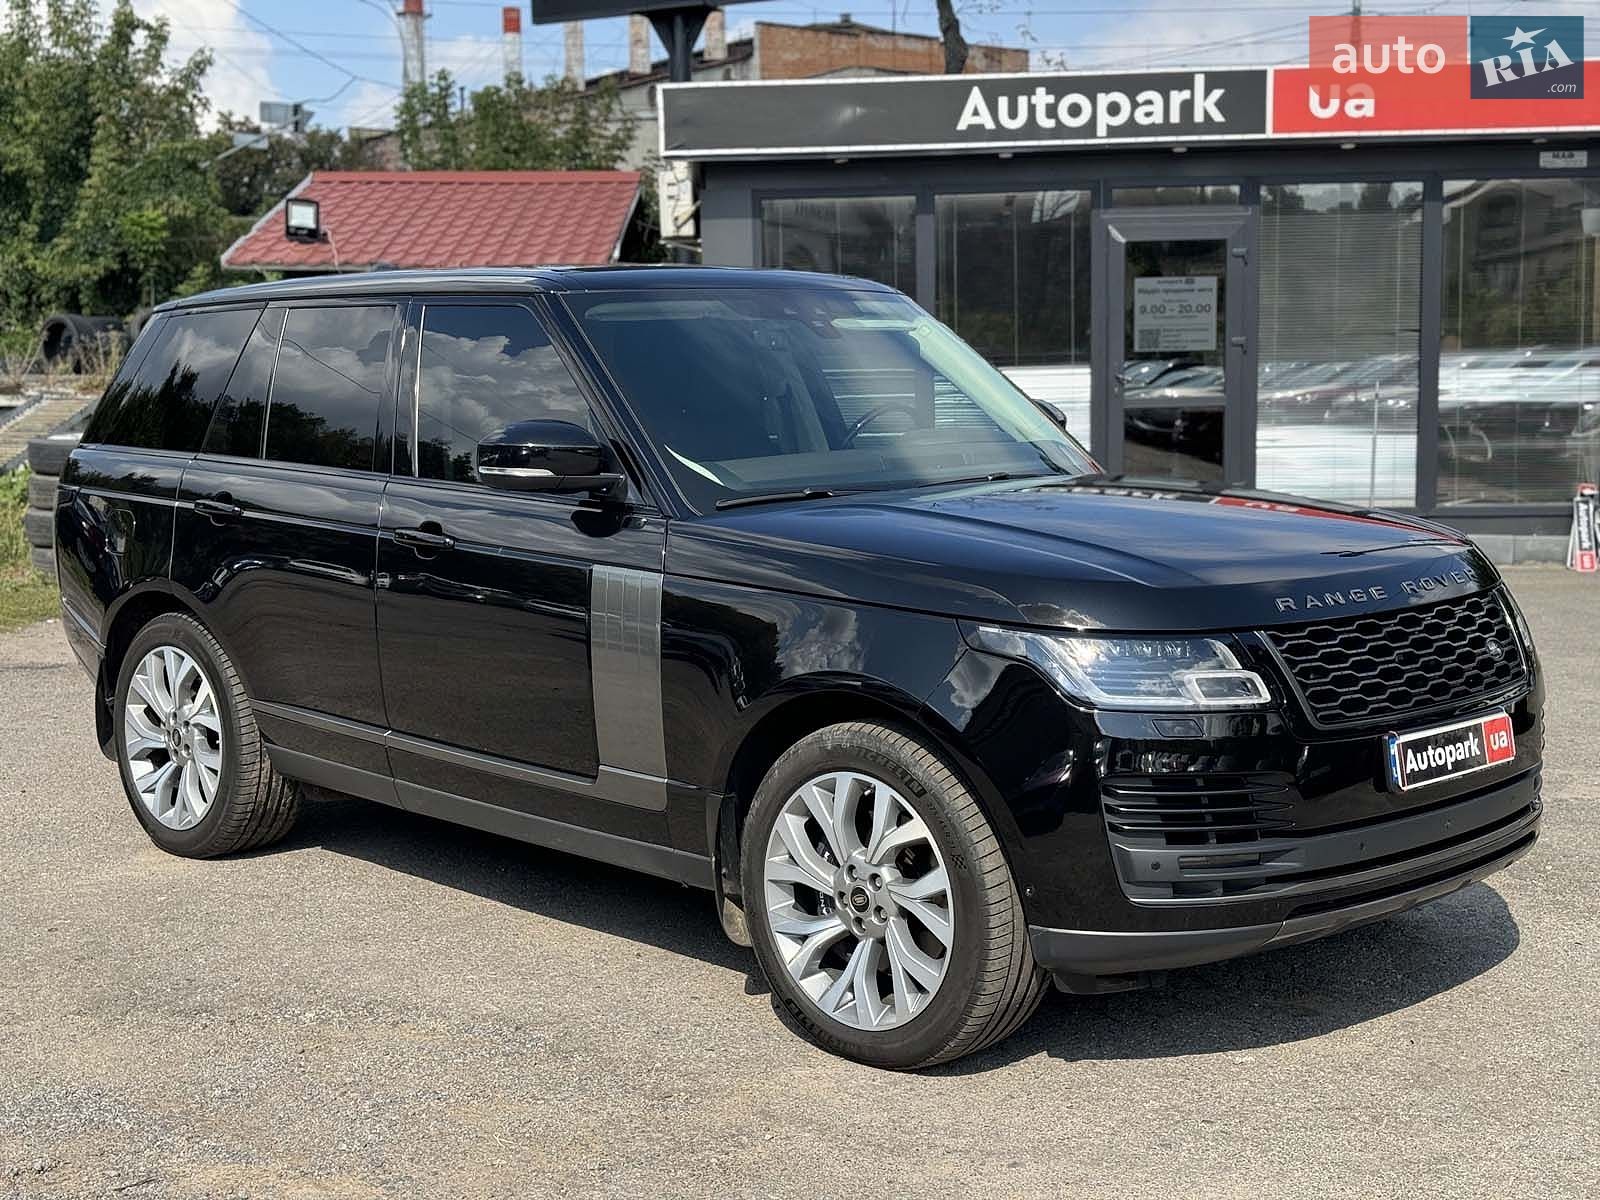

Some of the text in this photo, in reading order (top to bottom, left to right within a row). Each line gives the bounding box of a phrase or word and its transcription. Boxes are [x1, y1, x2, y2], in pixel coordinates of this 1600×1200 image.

[956, 74, 1375, 137] Autopark ua
[1178, 303, 1211, 314] 20.00
[1275, 568, 1477, 612] RANGE ROVER
[1405, 732, 1481, 774] Autopark
[1490, 730, 1508, 750] ua
